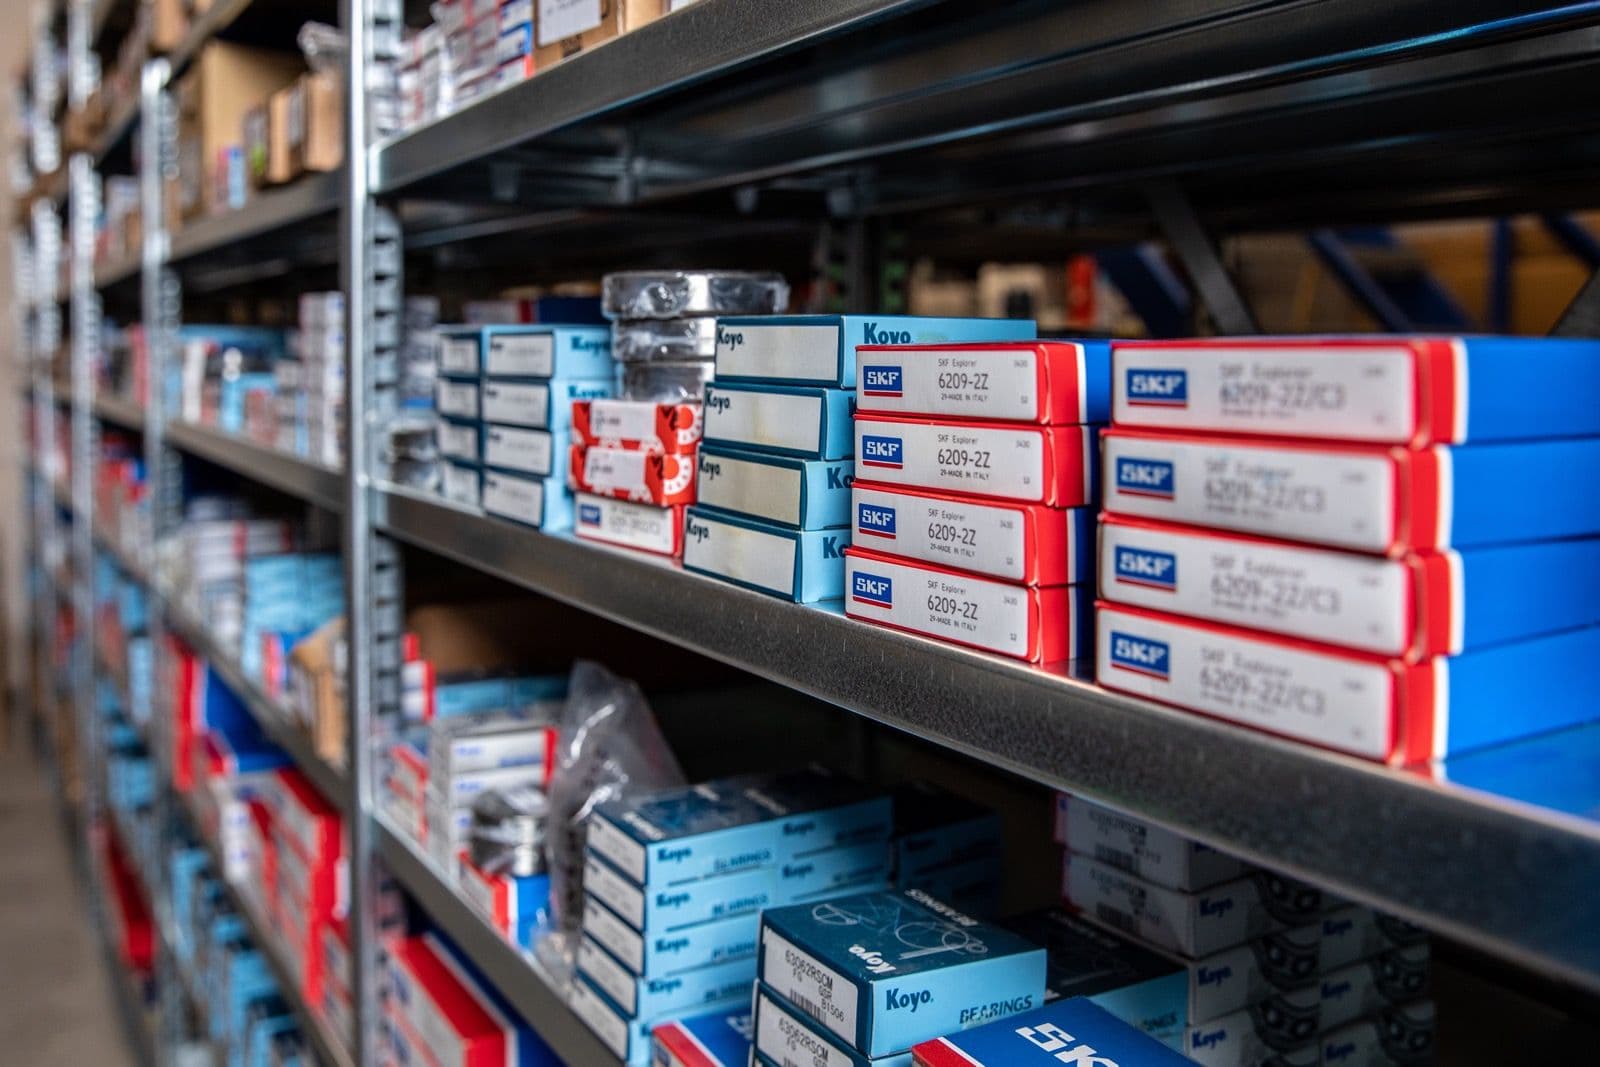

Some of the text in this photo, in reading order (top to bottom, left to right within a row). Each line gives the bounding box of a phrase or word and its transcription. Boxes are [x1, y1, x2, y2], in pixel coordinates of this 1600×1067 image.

[716, 327, 743, 350] Koyo
[938, 358, 977, 367] SKF Explorer
[866, 371, 899, 385] SKF
[938, 372, 989, 390] 6209-2Z
[1130, 373, 1183, 394] SKF
[704, 389, 730, 414] Koyo
[865, 441, 899, 456] SKF
[937, 433, 977, 445] SKF Explorer
[698, 453, 721, 480] Koyo
[937, 448, 991, 468] 6209-2Z
[826, 466, 853, 490] Ko
[1120, 462, 1169, 486] SKF
[862, 509, 892, 526] SKF
[928, 508, 965, 521] SKF Explorer
[686, 517, 709, 544] Koyo
[928, 522, 976, 546] 6209-2Z
[1118, 553, 1174, 577] SKF
[855, 577, 888, 595] SKF
[927, 580, 966, 594] SKF Explorer
[927, 594, 977, 620] 6209-2Z
[1114, 638, 1166, 662] SKF
[848, 943, 897, 974] Koyo
[886, 987, 1033, 1025] Koyo BEARINGS
